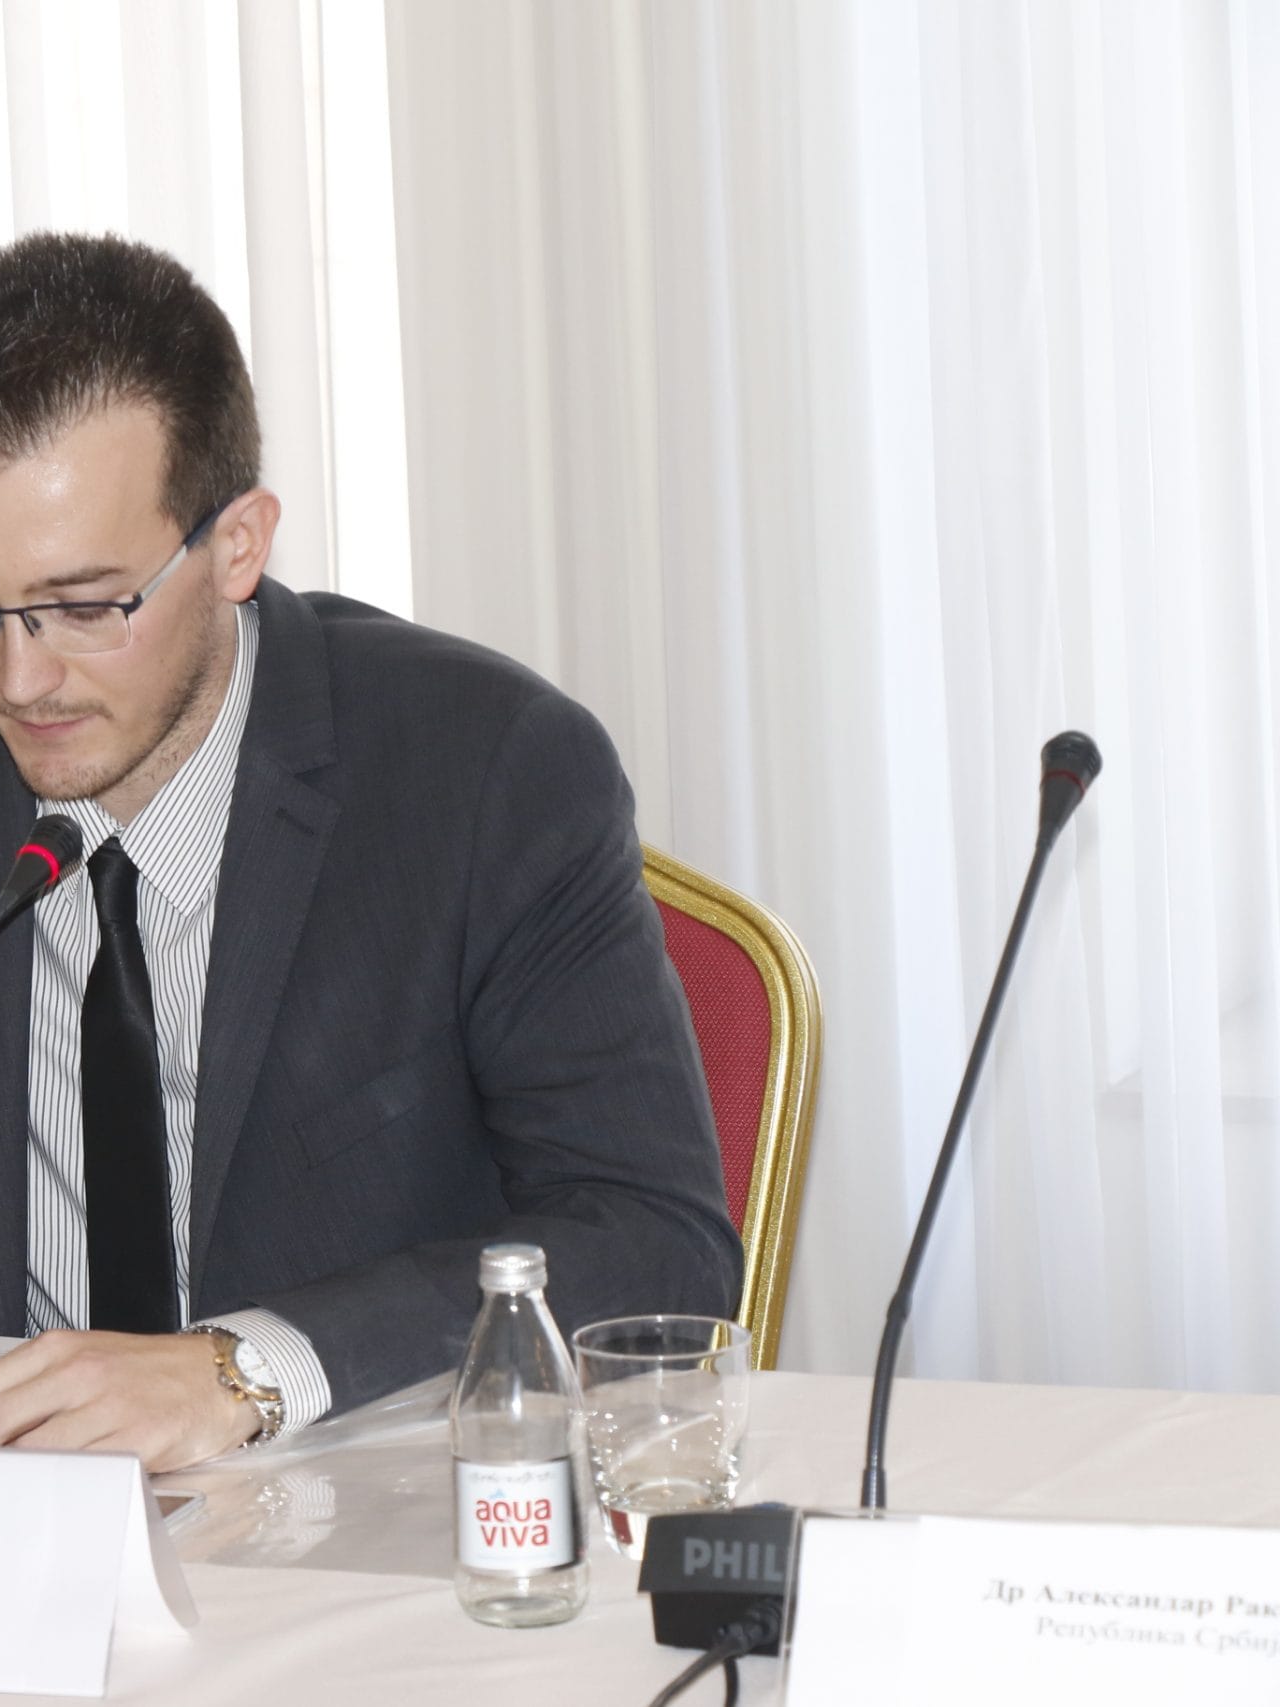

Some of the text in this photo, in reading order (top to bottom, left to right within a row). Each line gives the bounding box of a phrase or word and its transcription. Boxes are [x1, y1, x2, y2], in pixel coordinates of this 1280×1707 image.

[475, 1498, 552, 1523] aqua
[480, 1523, 550, 1547] viva
[984, 1579, 1025, 1606] Др
[1034, 1583, 1214, 1619] Александар
[1035, 1615, 1186, 1645] Република
